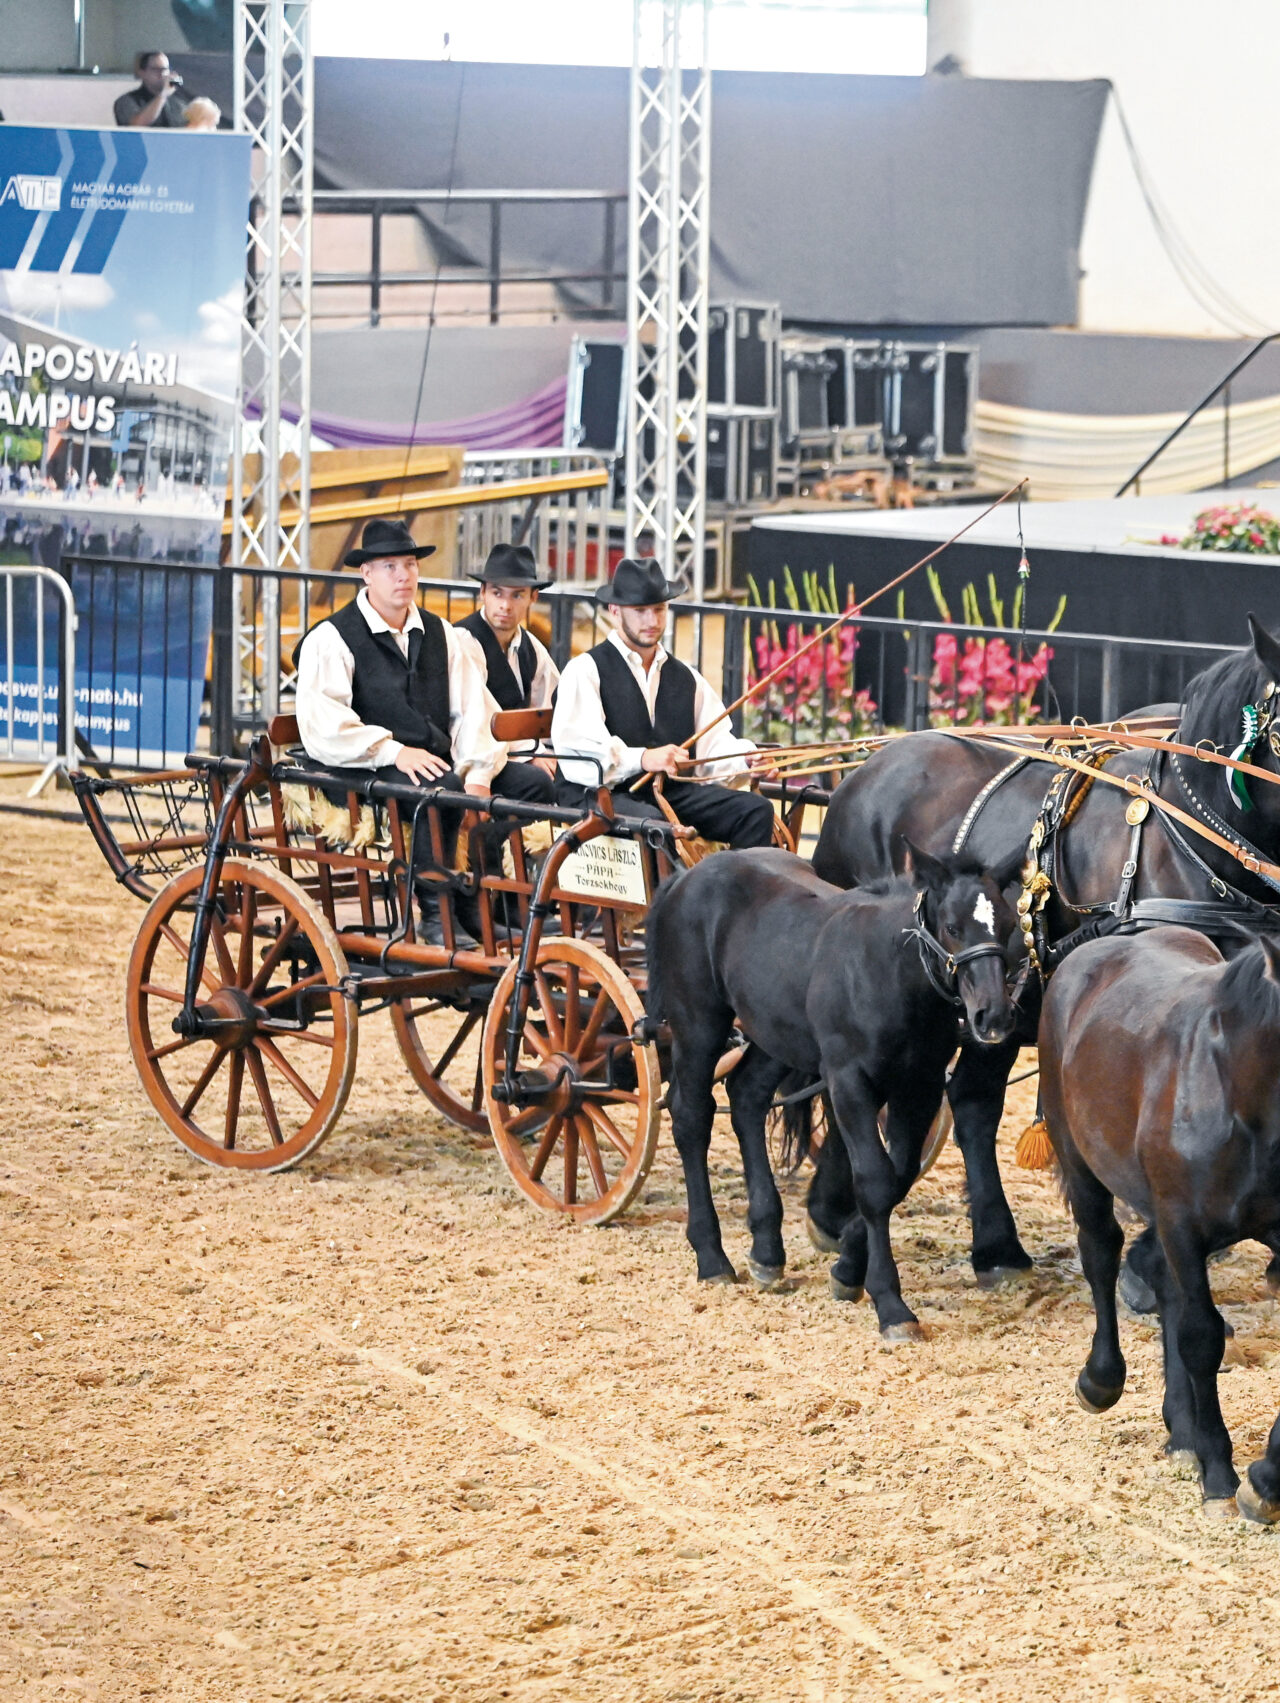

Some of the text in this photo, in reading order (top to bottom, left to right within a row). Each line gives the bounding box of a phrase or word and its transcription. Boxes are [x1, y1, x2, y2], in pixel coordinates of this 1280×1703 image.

[72, 182, 115, 195] MAGYAR
[149, 199, 195, 214] EGYETEM
[0, 340, 178, 386] APOSVÁRI
[0, 390, 116, 432] AMPUS
